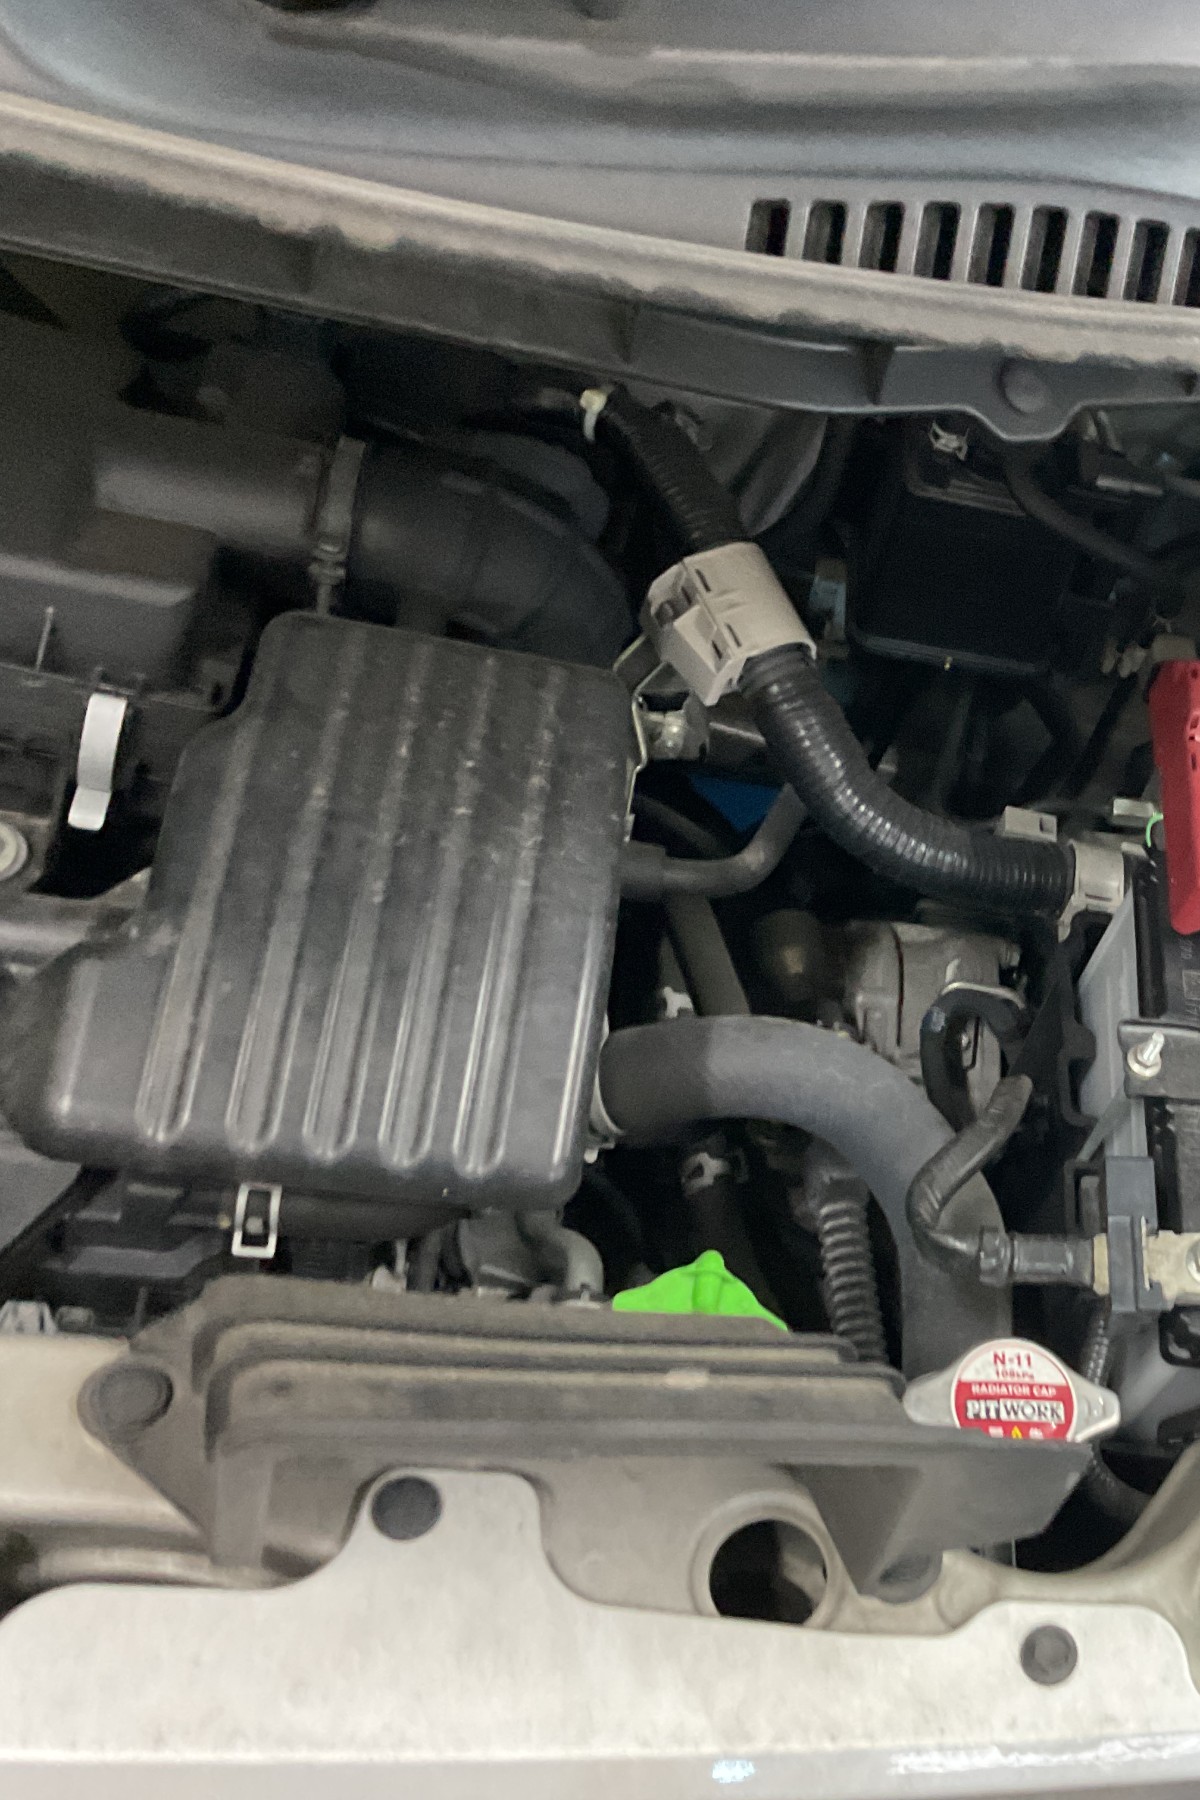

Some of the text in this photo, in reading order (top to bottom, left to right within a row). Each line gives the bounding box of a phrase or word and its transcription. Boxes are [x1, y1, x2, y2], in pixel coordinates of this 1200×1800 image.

[993, 1351, 1031, 1366] N-11
[972, 1384, 1057, 1397] RADIATOR CAP
[966, 1399, 1064, 1422] PITWORK
